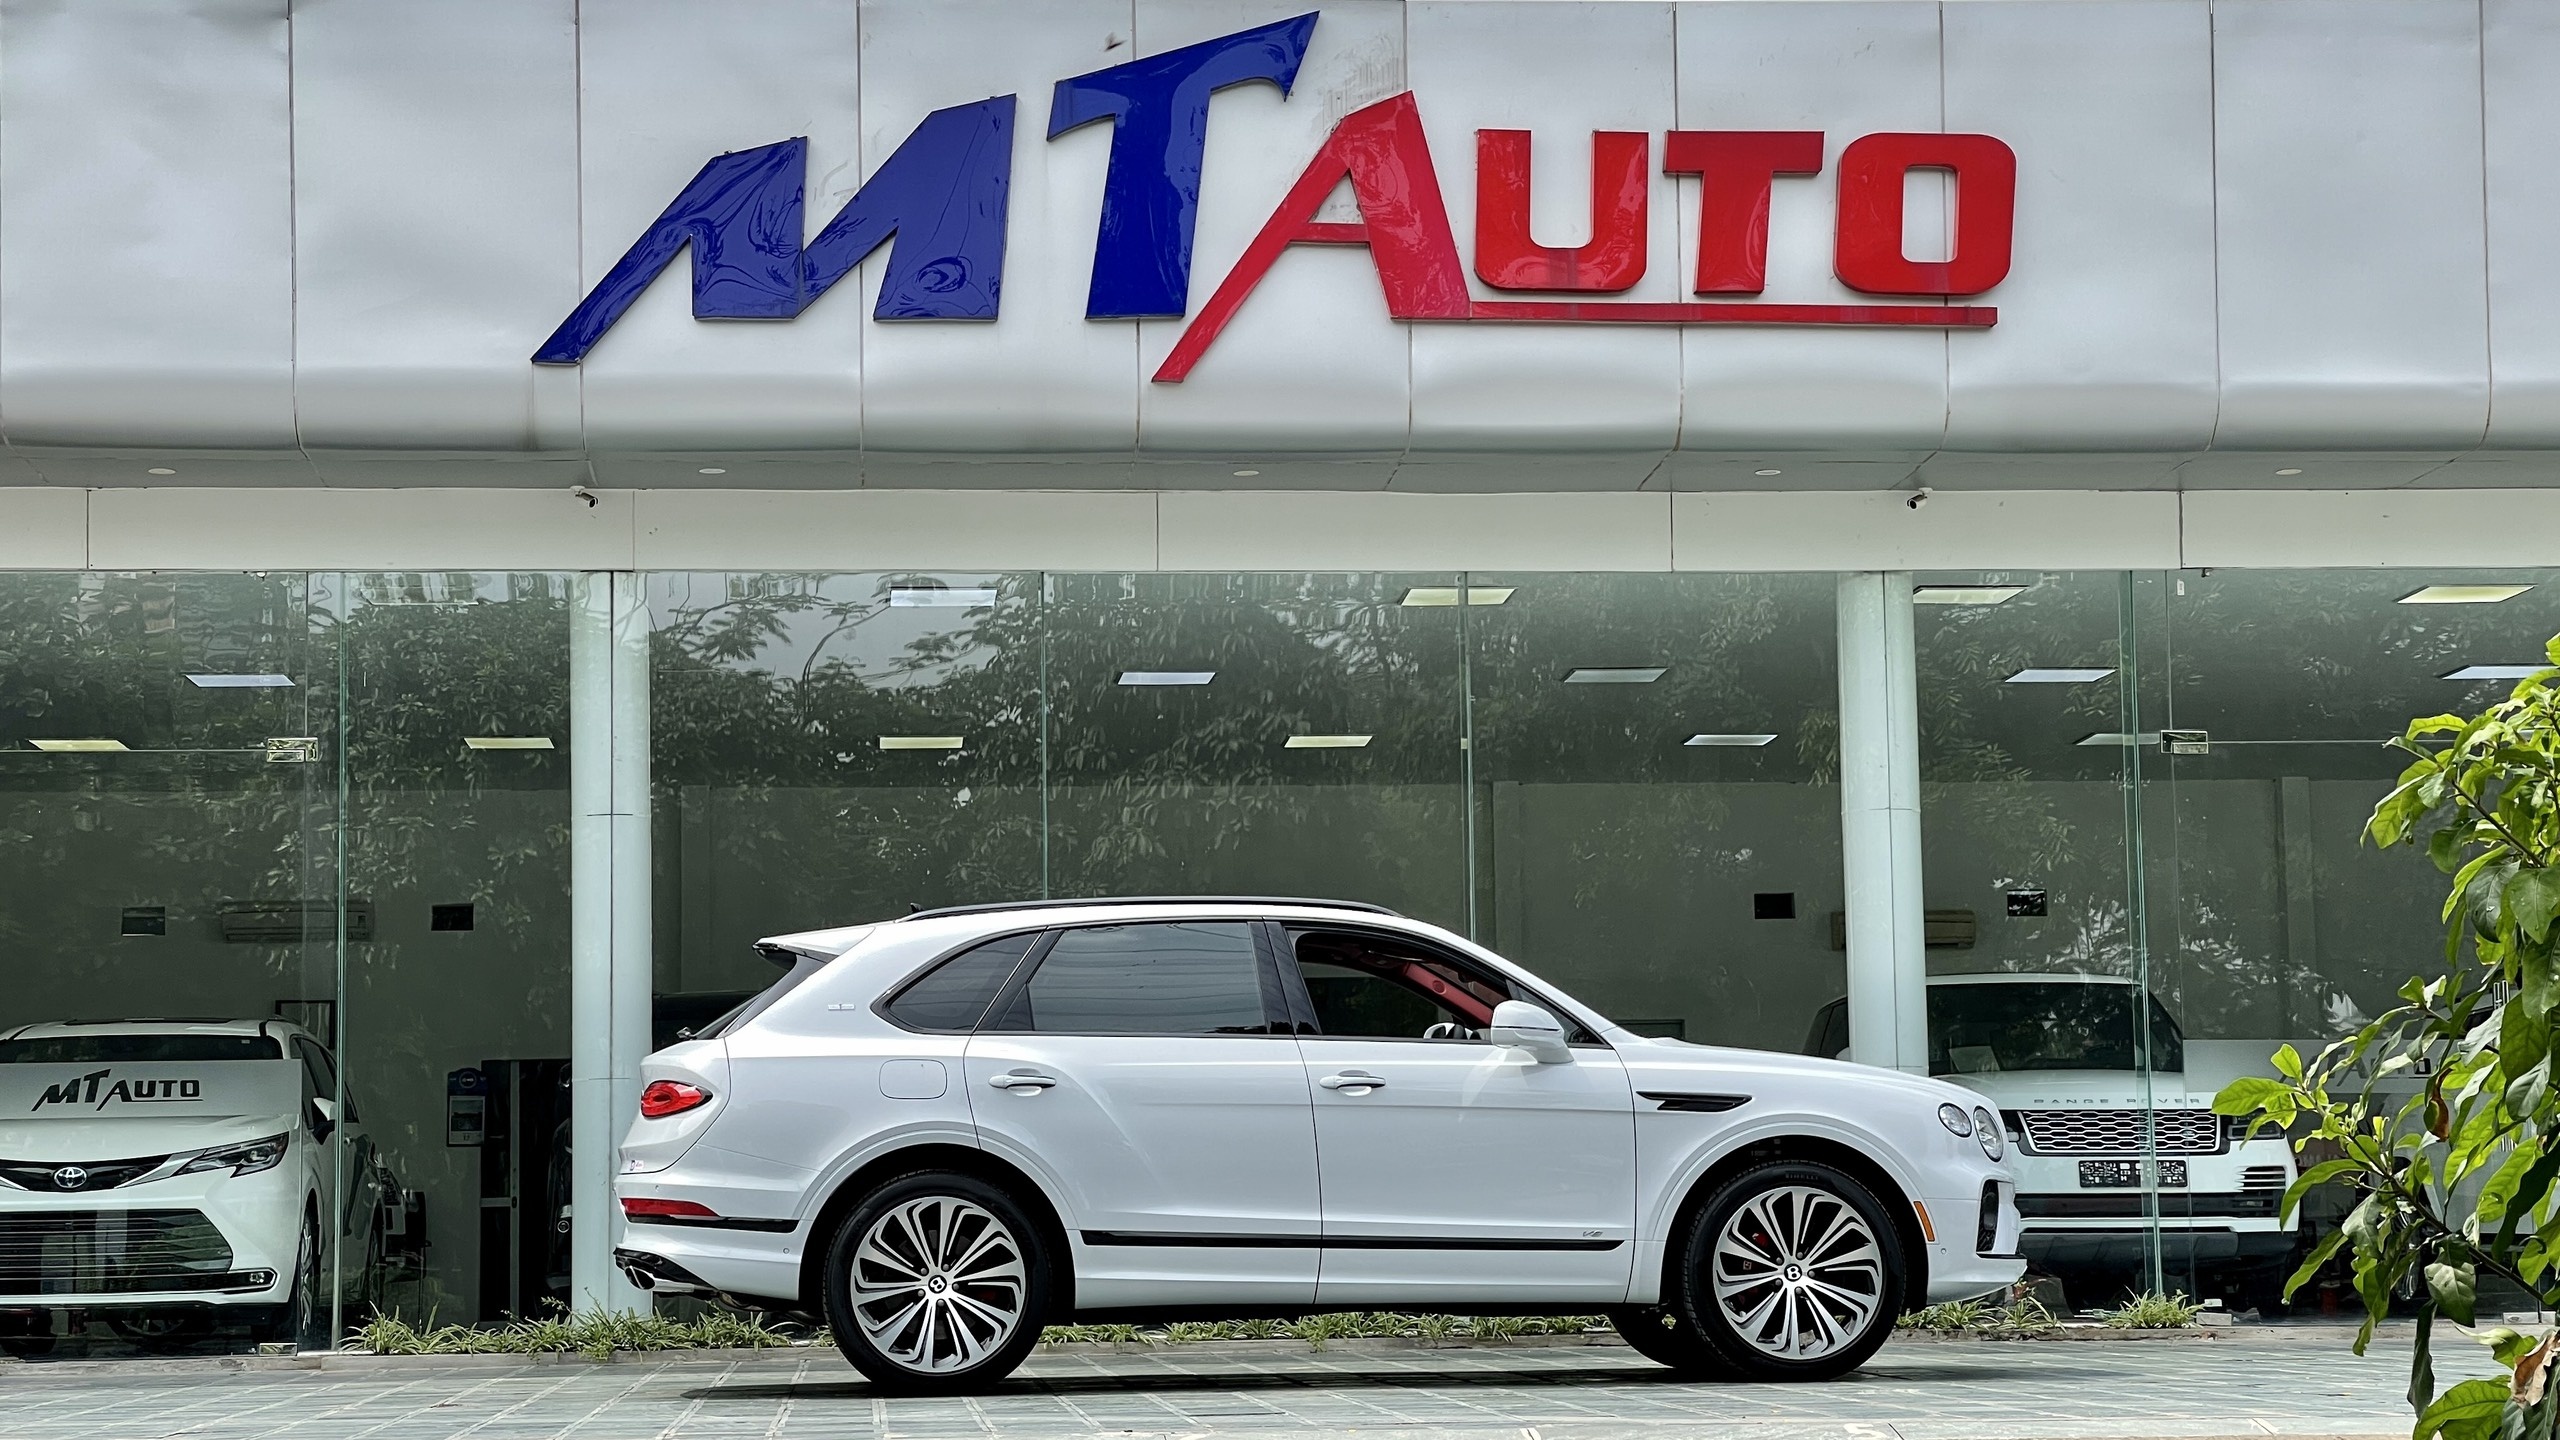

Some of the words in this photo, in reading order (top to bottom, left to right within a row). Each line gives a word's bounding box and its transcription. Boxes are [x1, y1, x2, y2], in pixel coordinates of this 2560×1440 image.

[1152, 90, 2018, 384] AUTO
[96, 1079, 202, 1111] AUTO
[929, 1276, 946, 1293] B
[1786, 1265, 1801, 1280] B
